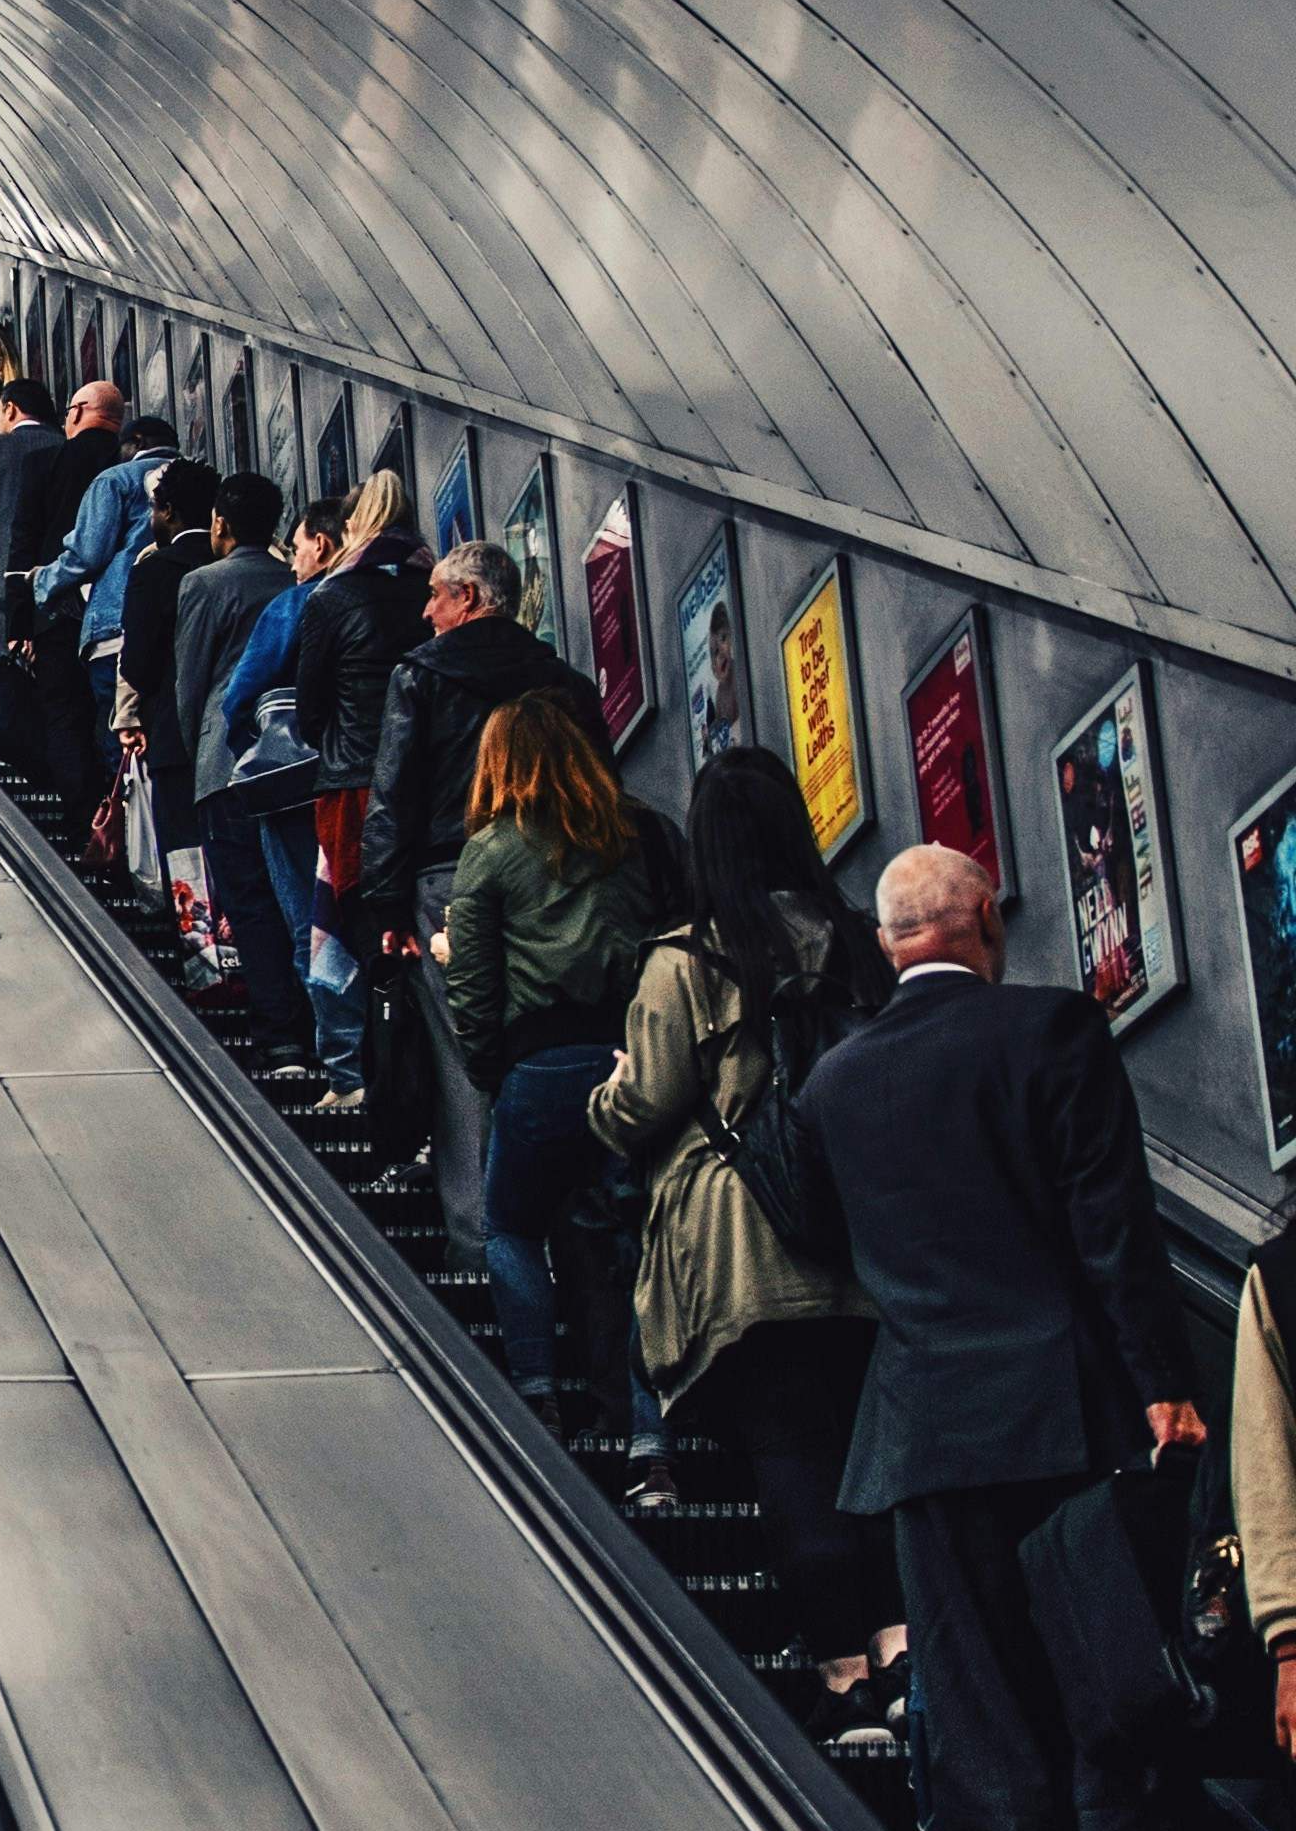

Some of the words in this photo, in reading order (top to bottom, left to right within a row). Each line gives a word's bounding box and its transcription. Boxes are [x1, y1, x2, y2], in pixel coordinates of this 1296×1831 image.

[798, 618, 823, 657] Train
[801, 661, 811, 685] to
[812, 644, 825, 670] be
[801, 694, 809, 713] a
[809, 657, 832, 703] chef
[808, 696, 828, 734] with
[805, 720, 836, 766] Leiths
[1077, 878, 1113, 937] NELL
[1082, 902, 1129, 975] GWYNN
